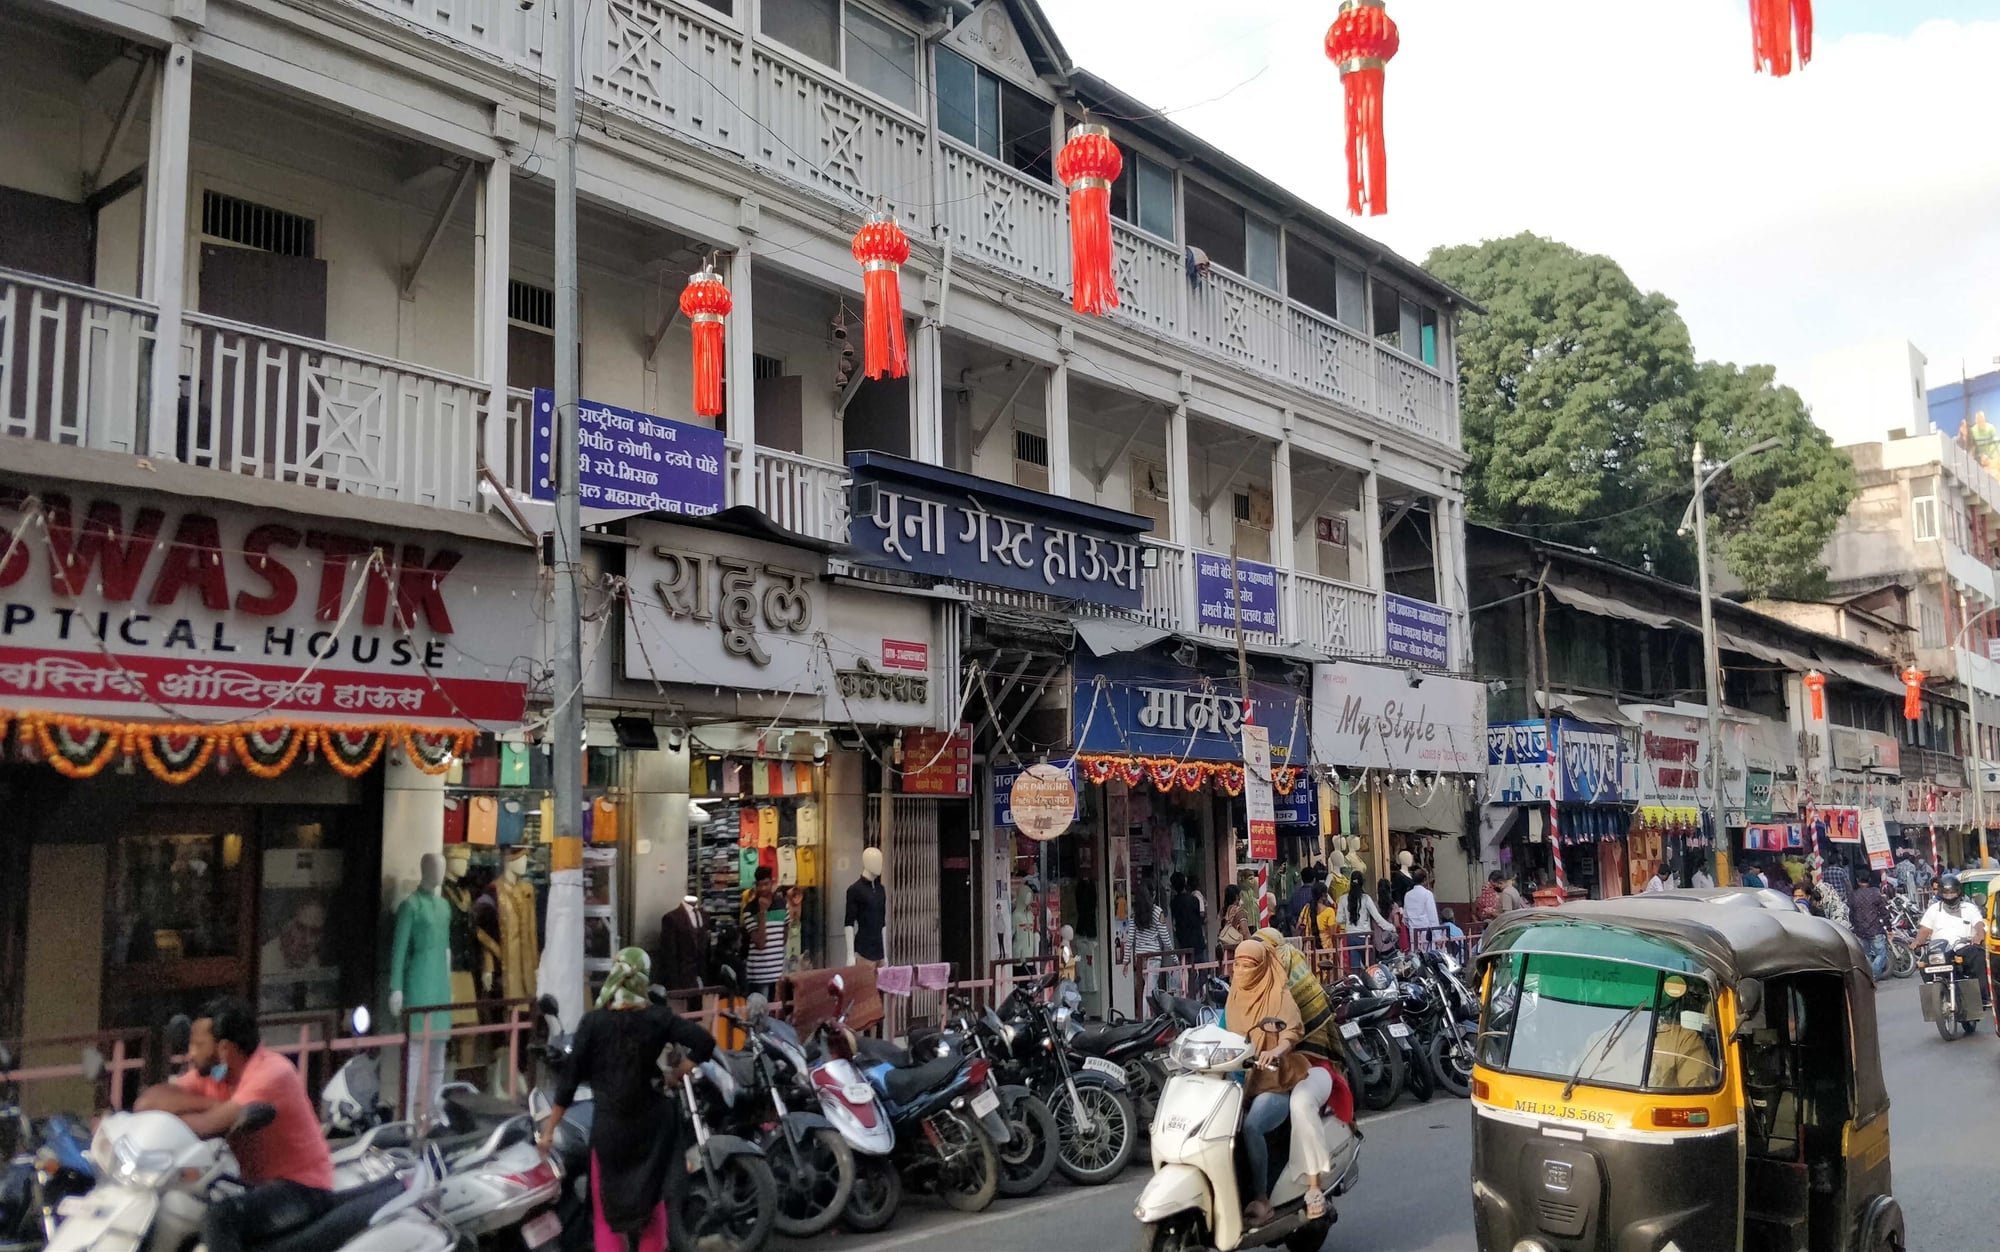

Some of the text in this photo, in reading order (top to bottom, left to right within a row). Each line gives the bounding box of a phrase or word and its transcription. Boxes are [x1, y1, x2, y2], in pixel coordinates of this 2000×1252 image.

[579, 407, 677, 442] राष्ट्रीयन भोजन
[618, 437, 652, 460] लोणी
[665, 449, 693, 469] दडपे
[696, 453, 719, 476] पोहे
[872, 489, 1140, 591] पूना गेस्ट हाऊस
[655, 545, 815, 666] राहूल
[1239, 609, 1262, 624] पलब्ध
[0, 603, 446, 669] PTICAL HOUSE
[0, 656, 426, 711] वस्तिक ऑप्टिकल हाऊस
[1336, 694, 1371, 751] My
[1381, 699, 1436, 754] Style
[1515, 1100, 1613, 1125] MH.12.JS.5687
